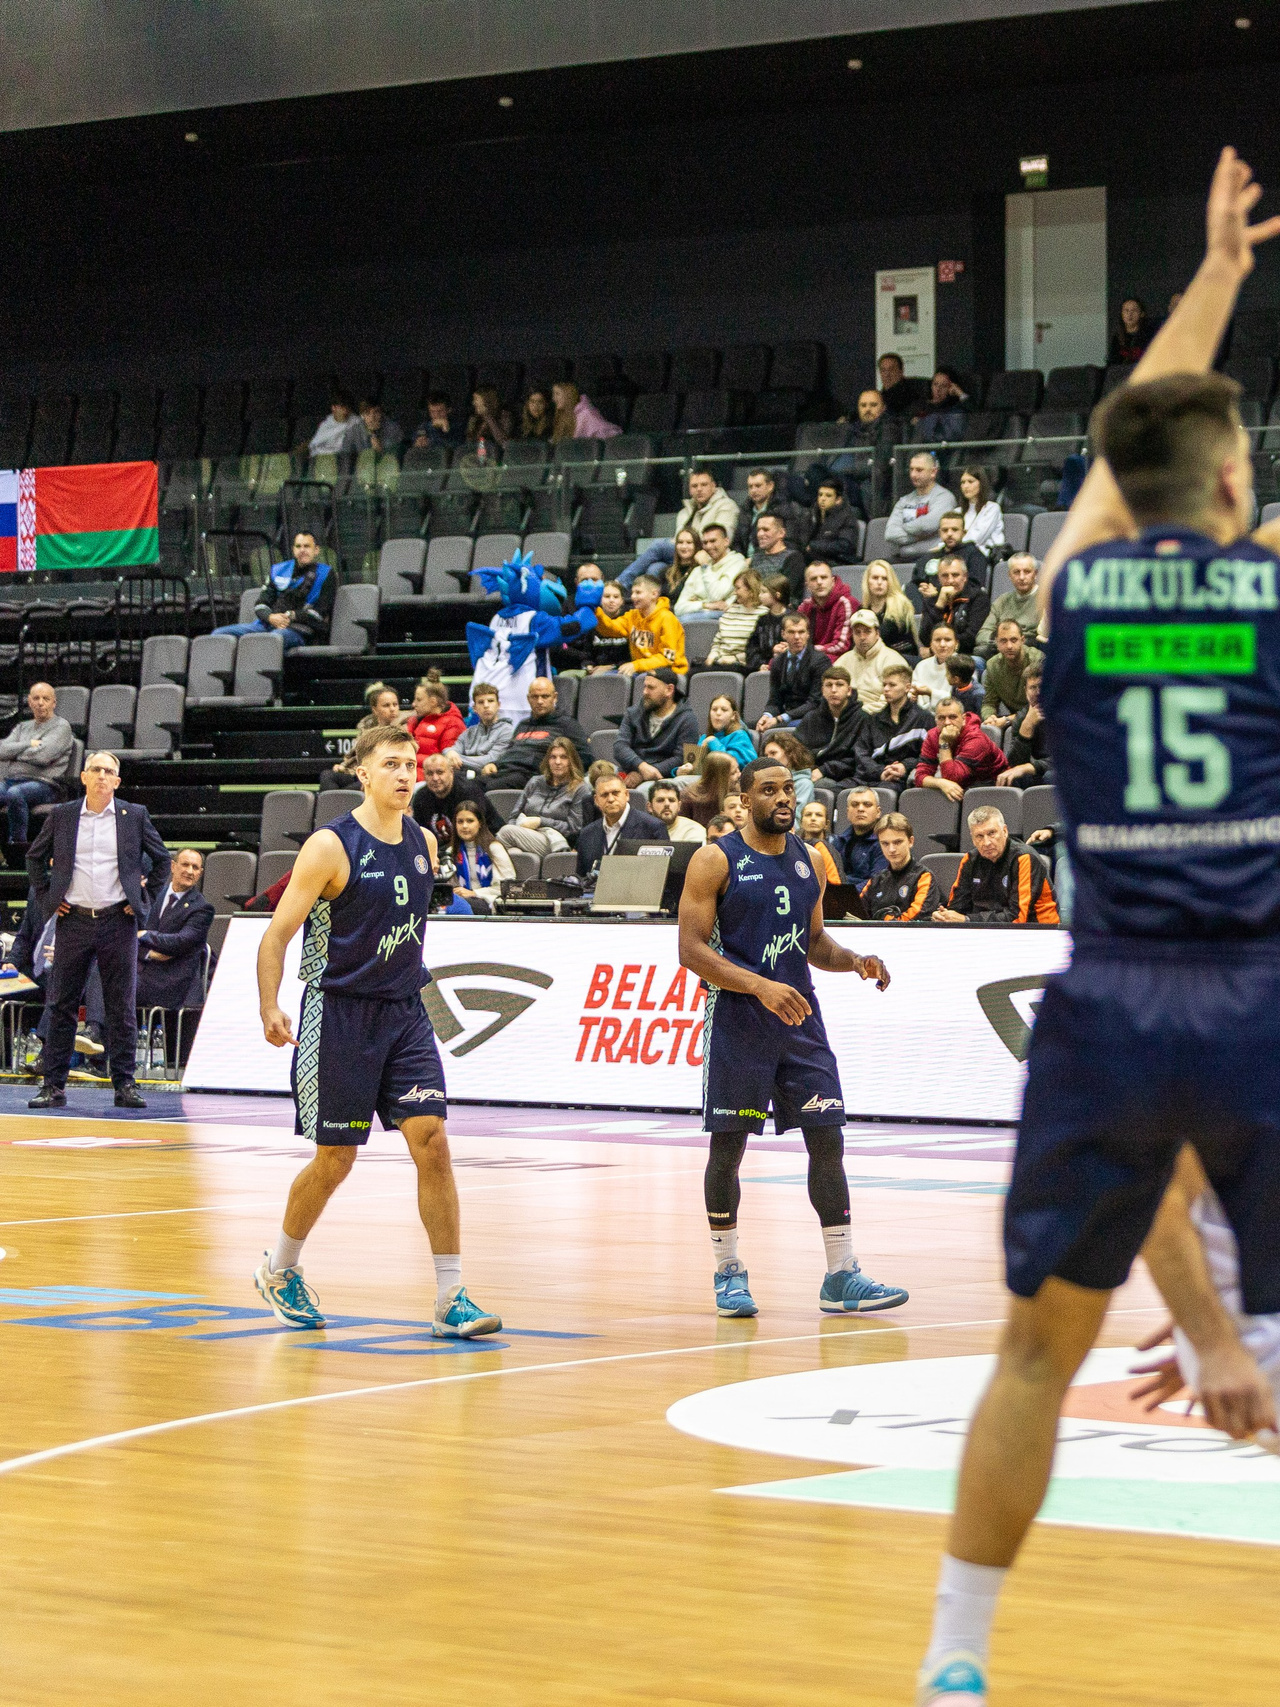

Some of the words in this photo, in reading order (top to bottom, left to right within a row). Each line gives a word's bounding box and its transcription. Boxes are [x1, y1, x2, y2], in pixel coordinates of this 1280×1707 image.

[1064, 557, 1279, 611] MIKULSKI
[1116, 686, 1232, 813] 15
[361, 871, 385, 879] Kempa
[738, 873, 763, 882] Kempa
[394, 875, 409, 906] 9
[774, 885, 791, 915] 3
[713, 1107, 736, 1115] Kempa
[323, 1120, 349, 1130] Kempa
